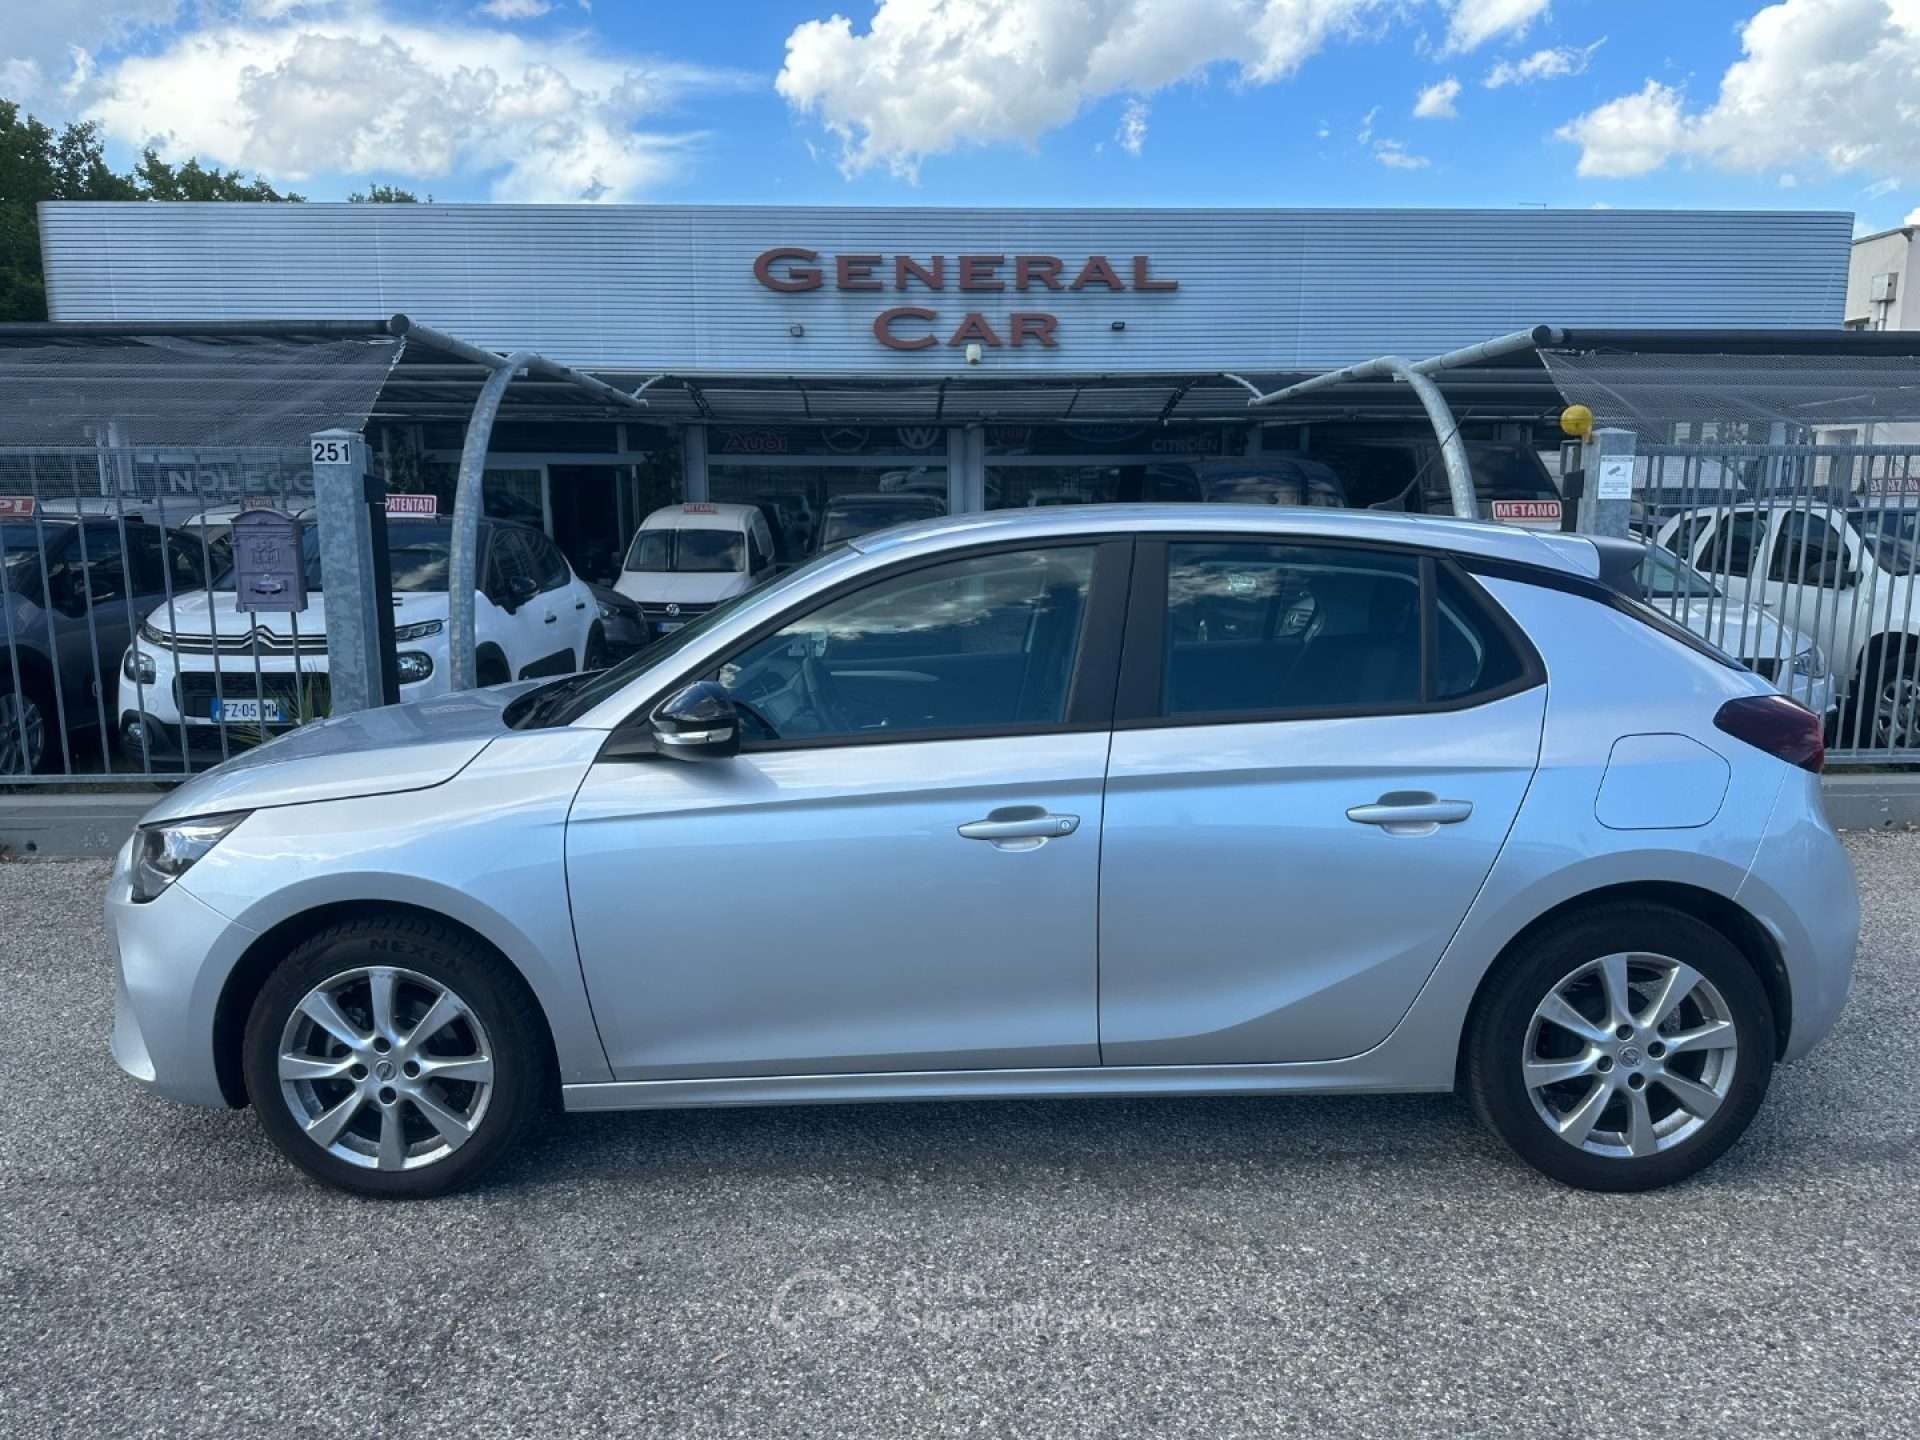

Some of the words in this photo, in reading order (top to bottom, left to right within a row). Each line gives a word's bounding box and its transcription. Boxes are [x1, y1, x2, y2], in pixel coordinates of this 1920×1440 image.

[753, 247, 1179, 292] GENERAL
[873, 307, 1060, 351] CAR
[313, 442, 351, 463] 251
[385, 497, 433, 513] PATENTATI
[1496, 503, 1559, 518] METANO
